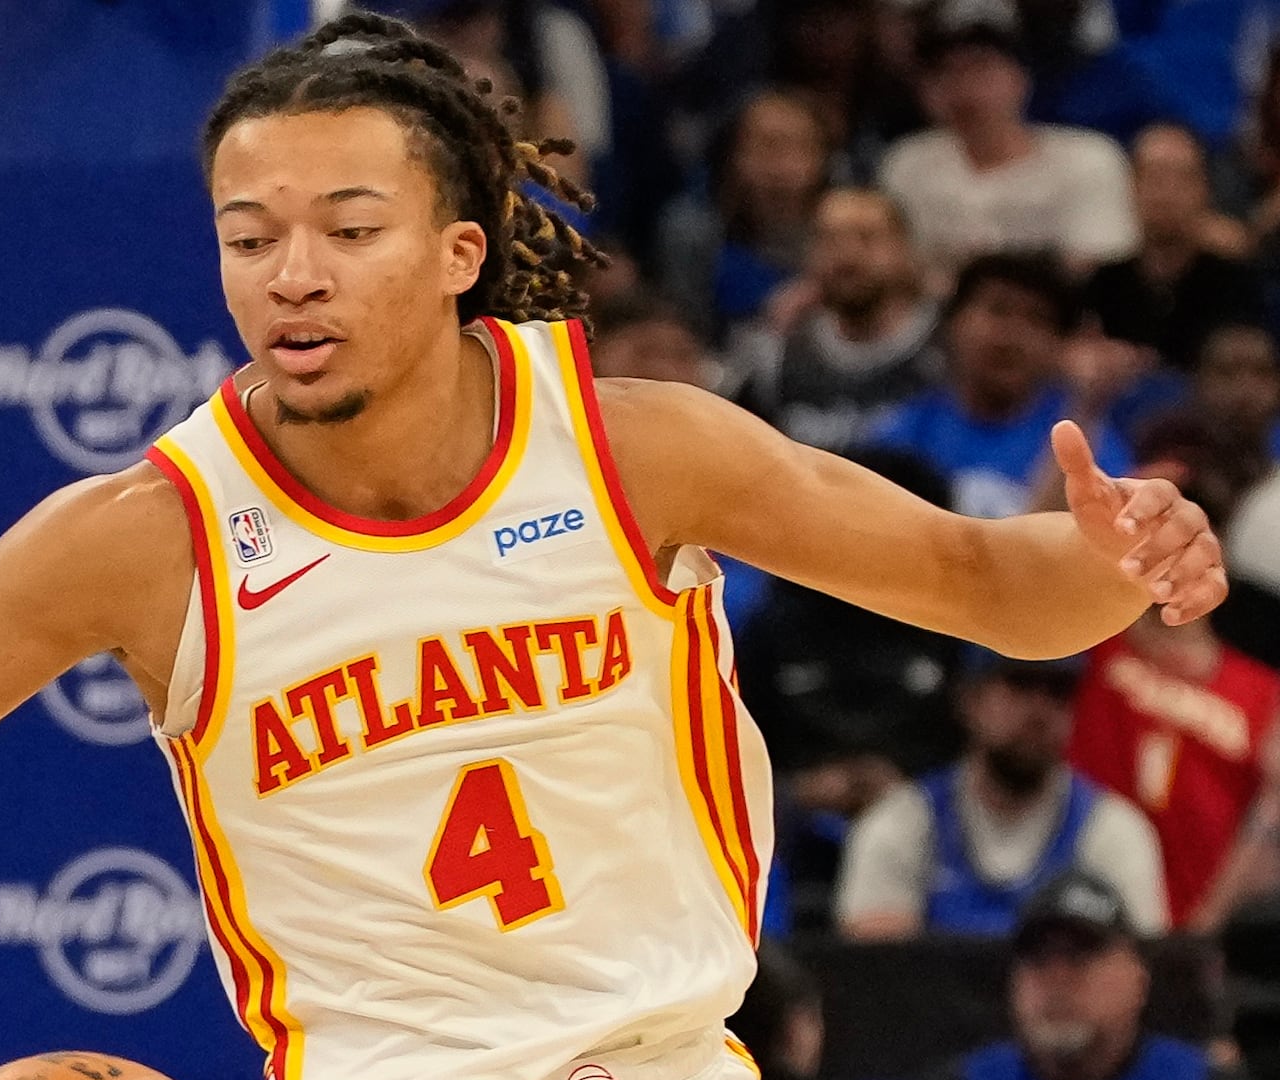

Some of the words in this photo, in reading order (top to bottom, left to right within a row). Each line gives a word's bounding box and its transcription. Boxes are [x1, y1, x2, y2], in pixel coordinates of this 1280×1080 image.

[494, 509, 584, 557] paze
[250, 606, 634, 799] ATLANTA
[422, 757, 566, 933] 4
